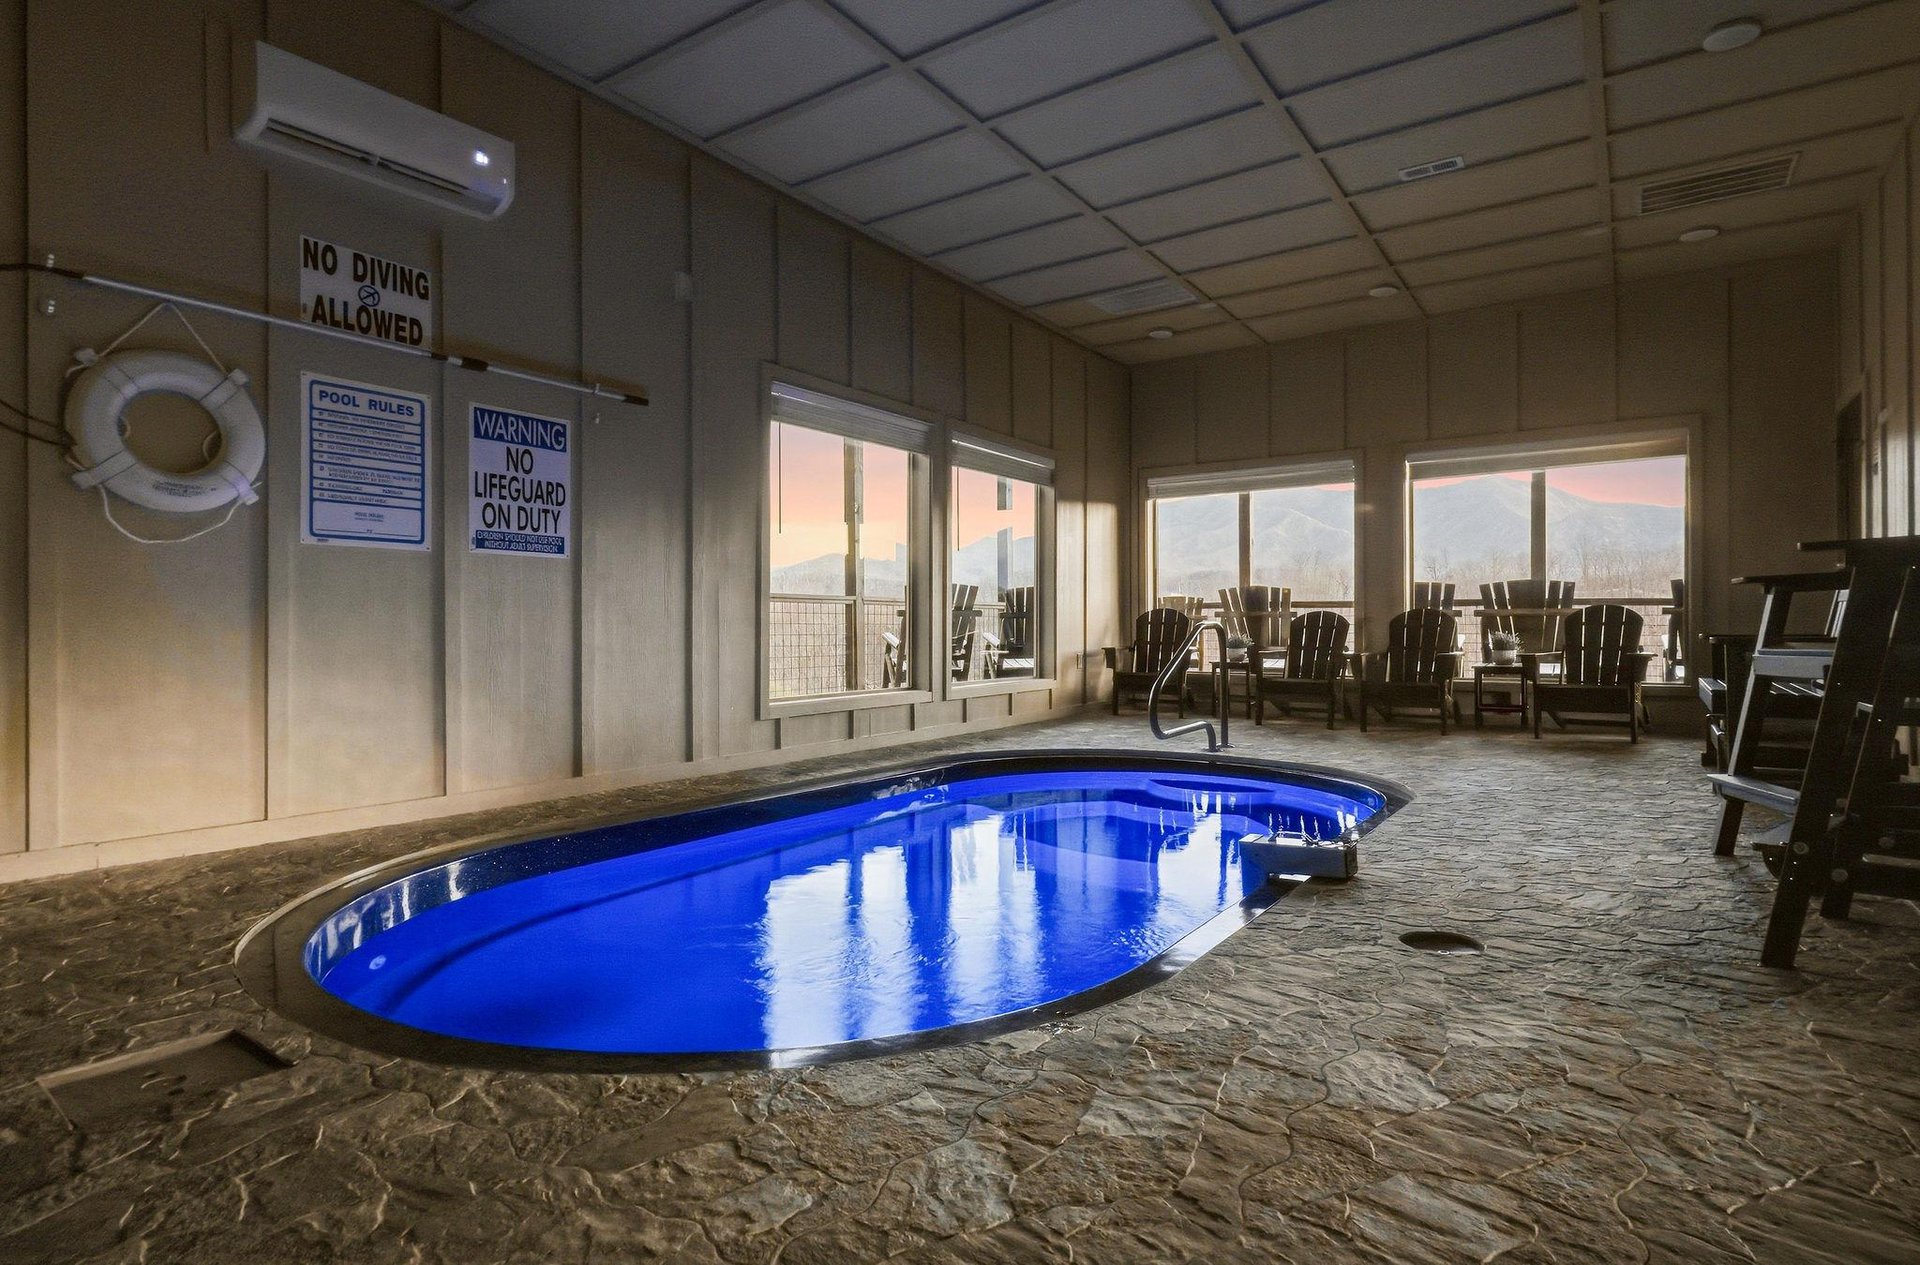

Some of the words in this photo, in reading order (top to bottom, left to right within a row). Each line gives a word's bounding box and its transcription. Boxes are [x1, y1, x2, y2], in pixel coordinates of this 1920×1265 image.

[303, 238, 338, 276] NO
[352, 252, 430, 301] DIVING
[311, 294, 423, 347] ALLOWED
[318, 389, 360, 408] POOL
[368, 398, 415, 417] RULES
[476, 410, 565, 451] WARNING
[506, 446, 534, 475] NO
[474, 471, 566, 507] LIFEGUARD
[481, 502, 511, 530] ON
[517, 505, 561, 534] DUTY
